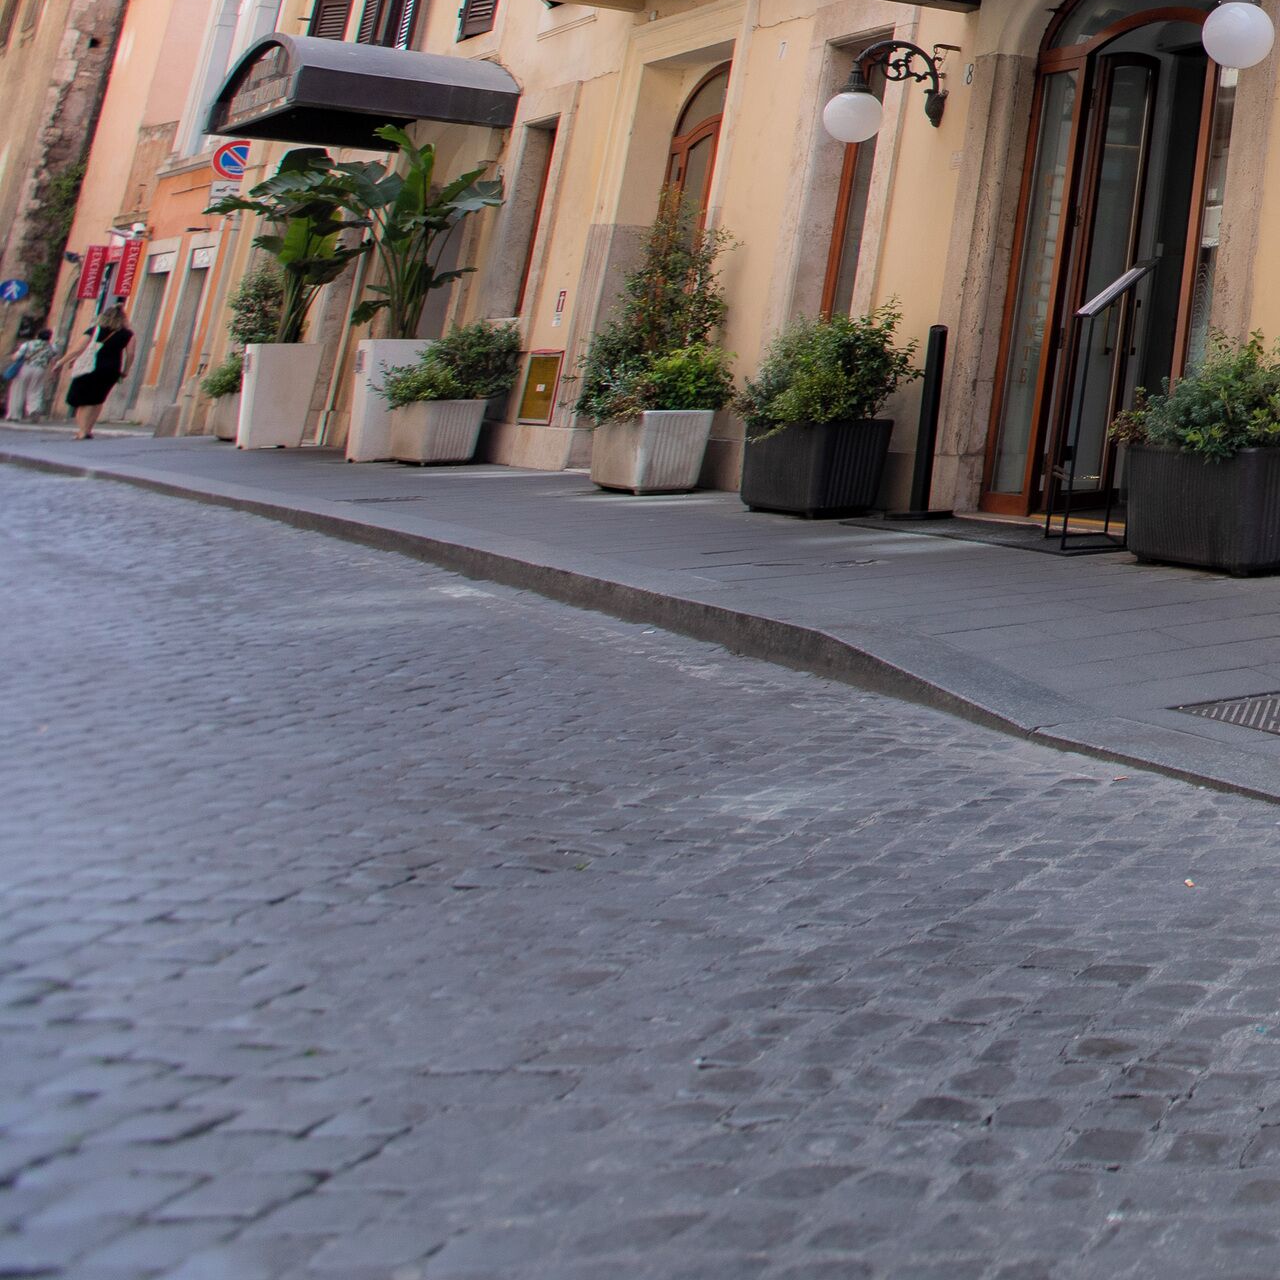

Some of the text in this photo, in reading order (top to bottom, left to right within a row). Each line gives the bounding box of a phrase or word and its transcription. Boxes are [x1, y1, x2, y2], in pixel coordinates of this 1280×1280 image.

[966, 63, 975, 85] 8
[82, 252, 101, 297] EXCHANGE
[120, 246, 140, 294] EXCHANGE
